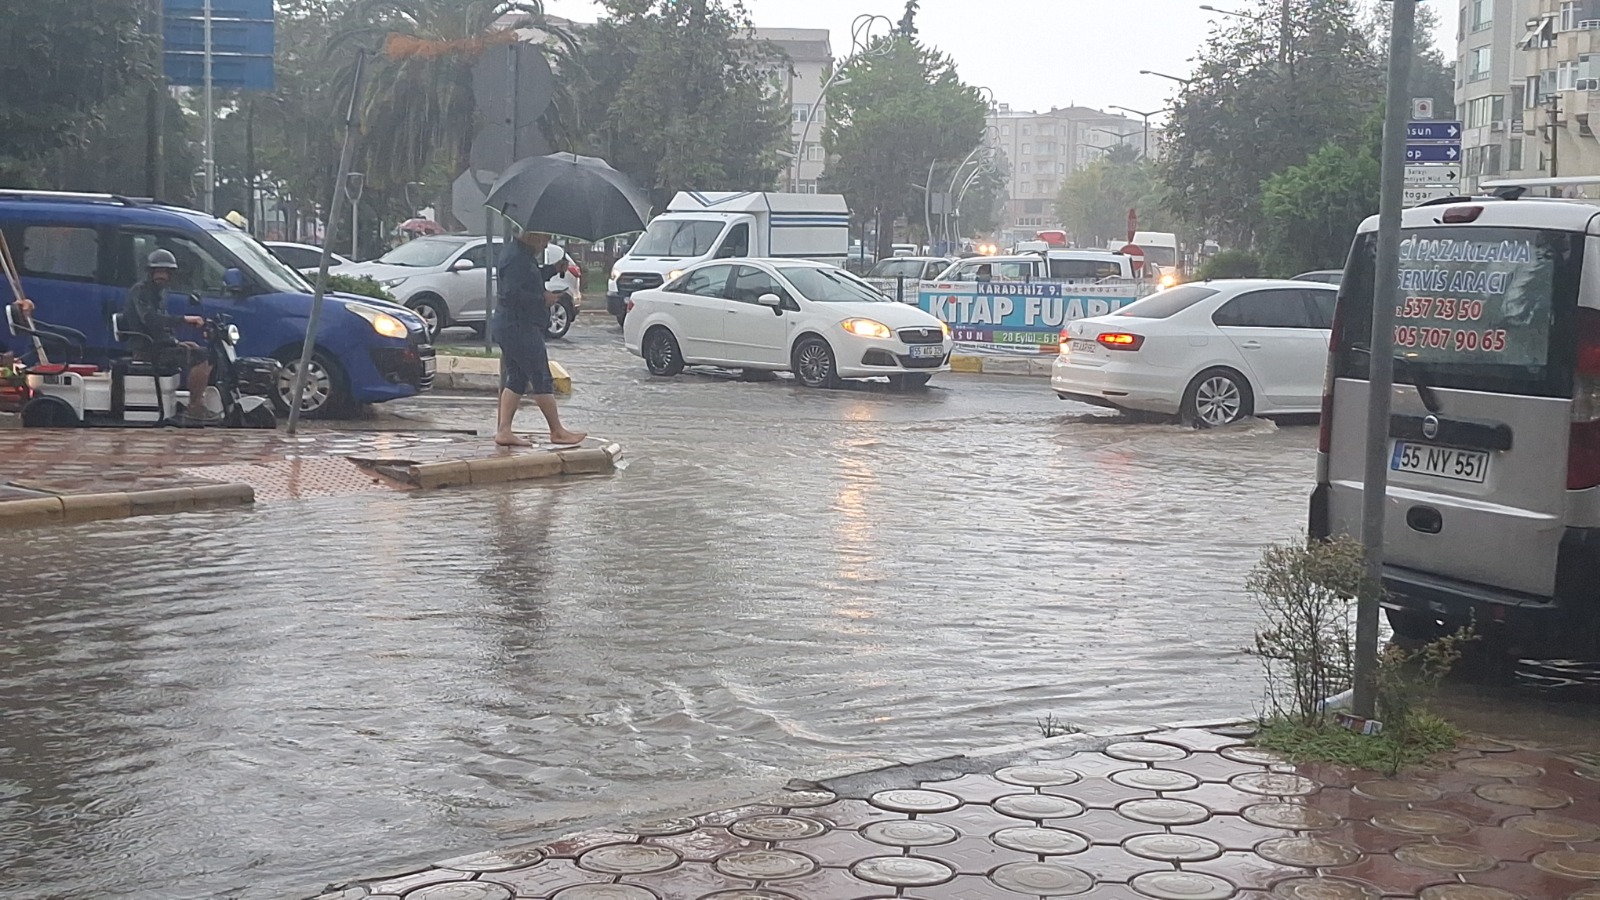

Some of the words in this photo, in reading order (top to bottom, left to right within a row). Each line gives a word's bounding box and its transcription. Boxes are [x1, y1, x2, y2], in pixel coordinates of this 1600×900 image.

[1407, 150, 1422, 159] op
[1405, 191, 1432, 200] togar
[1399, 234, 1417, 261] Cİ
[1416, 238, 1531, 262] PAZARLAMA
[978, 284, 1044, 295] KARADENİZ
[1049, 285, 1060, 296] 9.
[1449, 270, 1508, 294] ARACI
[929, 295, 1013, 325] KİTAP
[1403, 296, 1433, 318] 537
[1434, 298, 1456, 320] 23
[1457, 299, 1483, 321] 50
[1002, 332, 1014, 343] 28
[1015, 332, 1036, 344] Eylül
[1420, 327, 1451, 349] 707
[1454, 329, 1478, 351] 90
[1481, 329, 1506, 351] 65
[1401, 446, 1421, 468] 55
[1426, 449, 1452, 473] NY
[1454, 452, 1484, 478] 551
